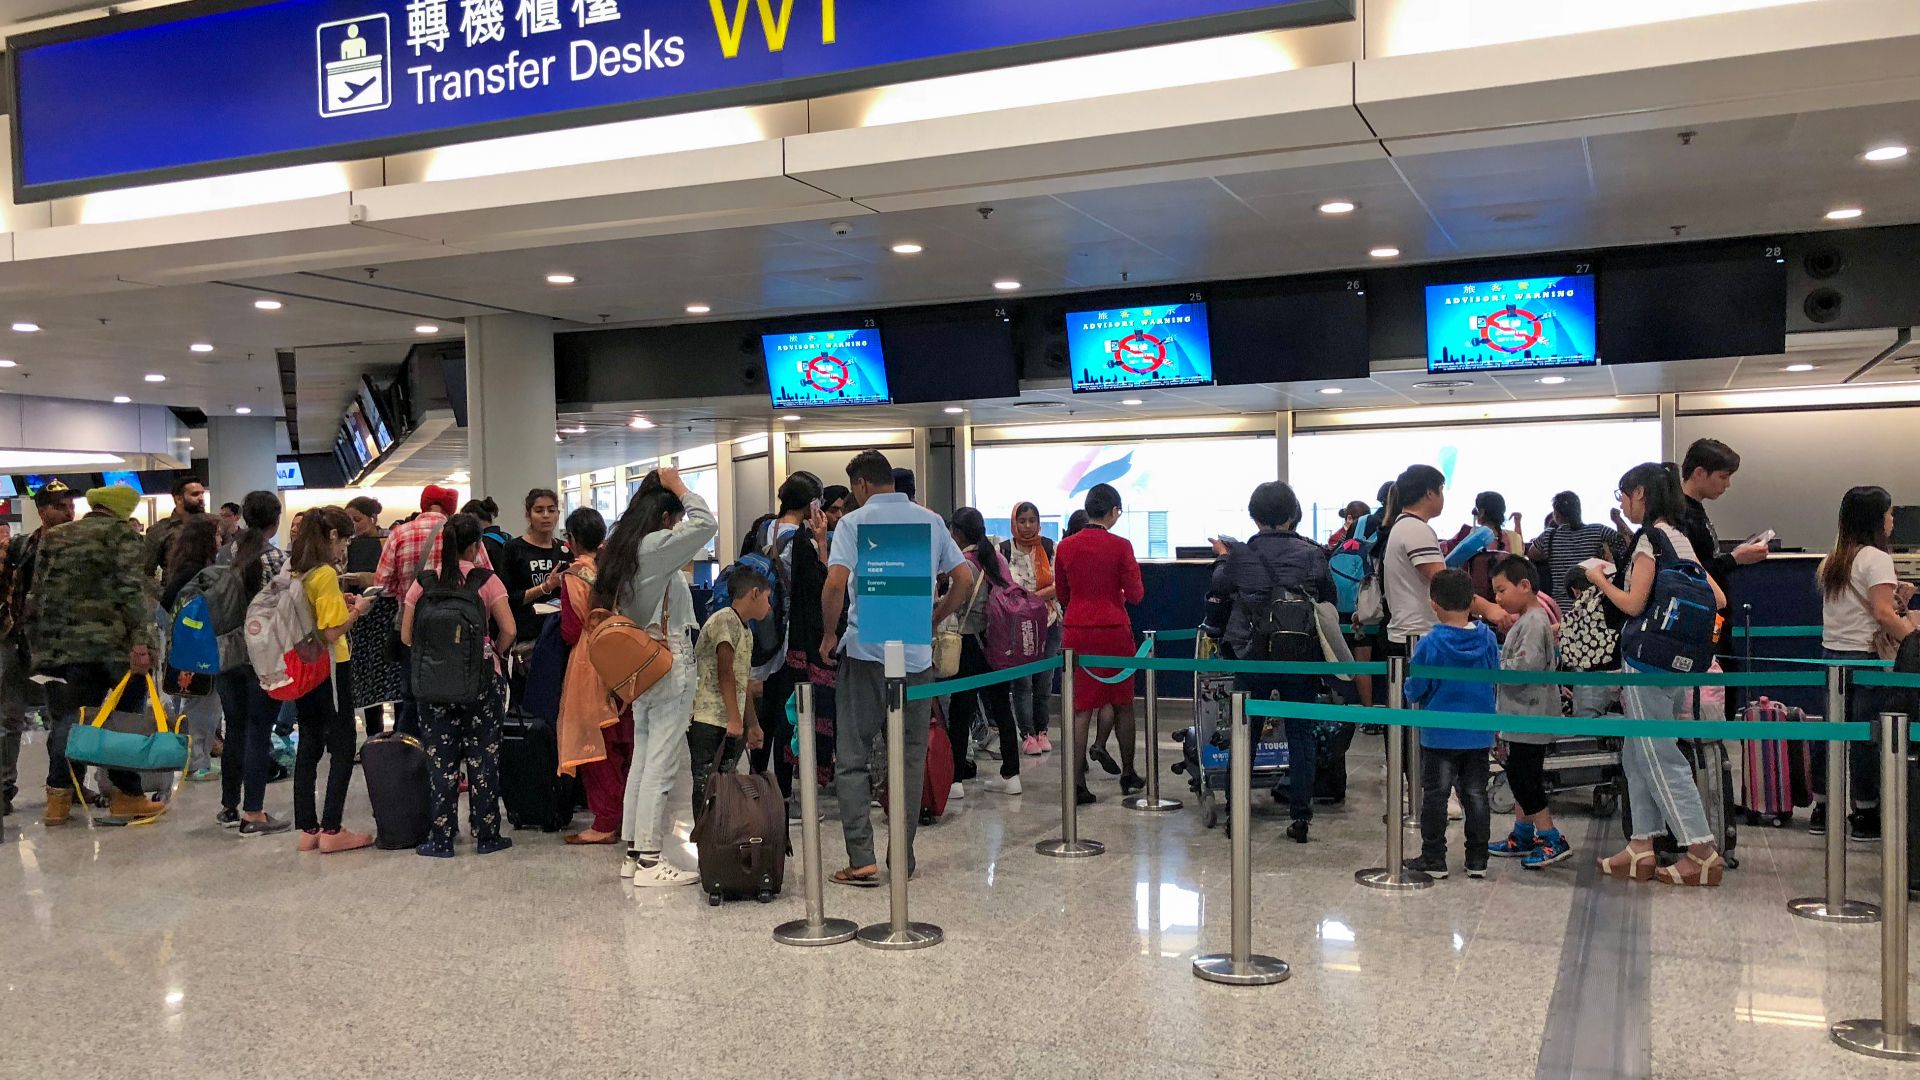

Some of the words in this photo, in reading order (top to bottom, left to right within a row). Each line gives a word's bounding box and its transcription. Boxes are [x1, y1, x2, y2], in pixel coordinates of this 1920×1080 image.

[407, 50, 556, 105] Transfer
[570, 28, 686, 82] Desks
[1765, 246, 1781, 257] 28
[1576, 264, 1590, 274] 27
[1346, 280, 1360, 290] 26
[1189, 293, 1202, 301] 25
[1445, 294, 1507, 305] ADVISORY
[1514, 289, 1575, 300] WARNING
[994, 308, 1006, 317] 24
[864, 319, 875, 327] 23
[1083, 320, 1135, 330] ADVISORY
[1141, 316, 1191, 326] WARNING
